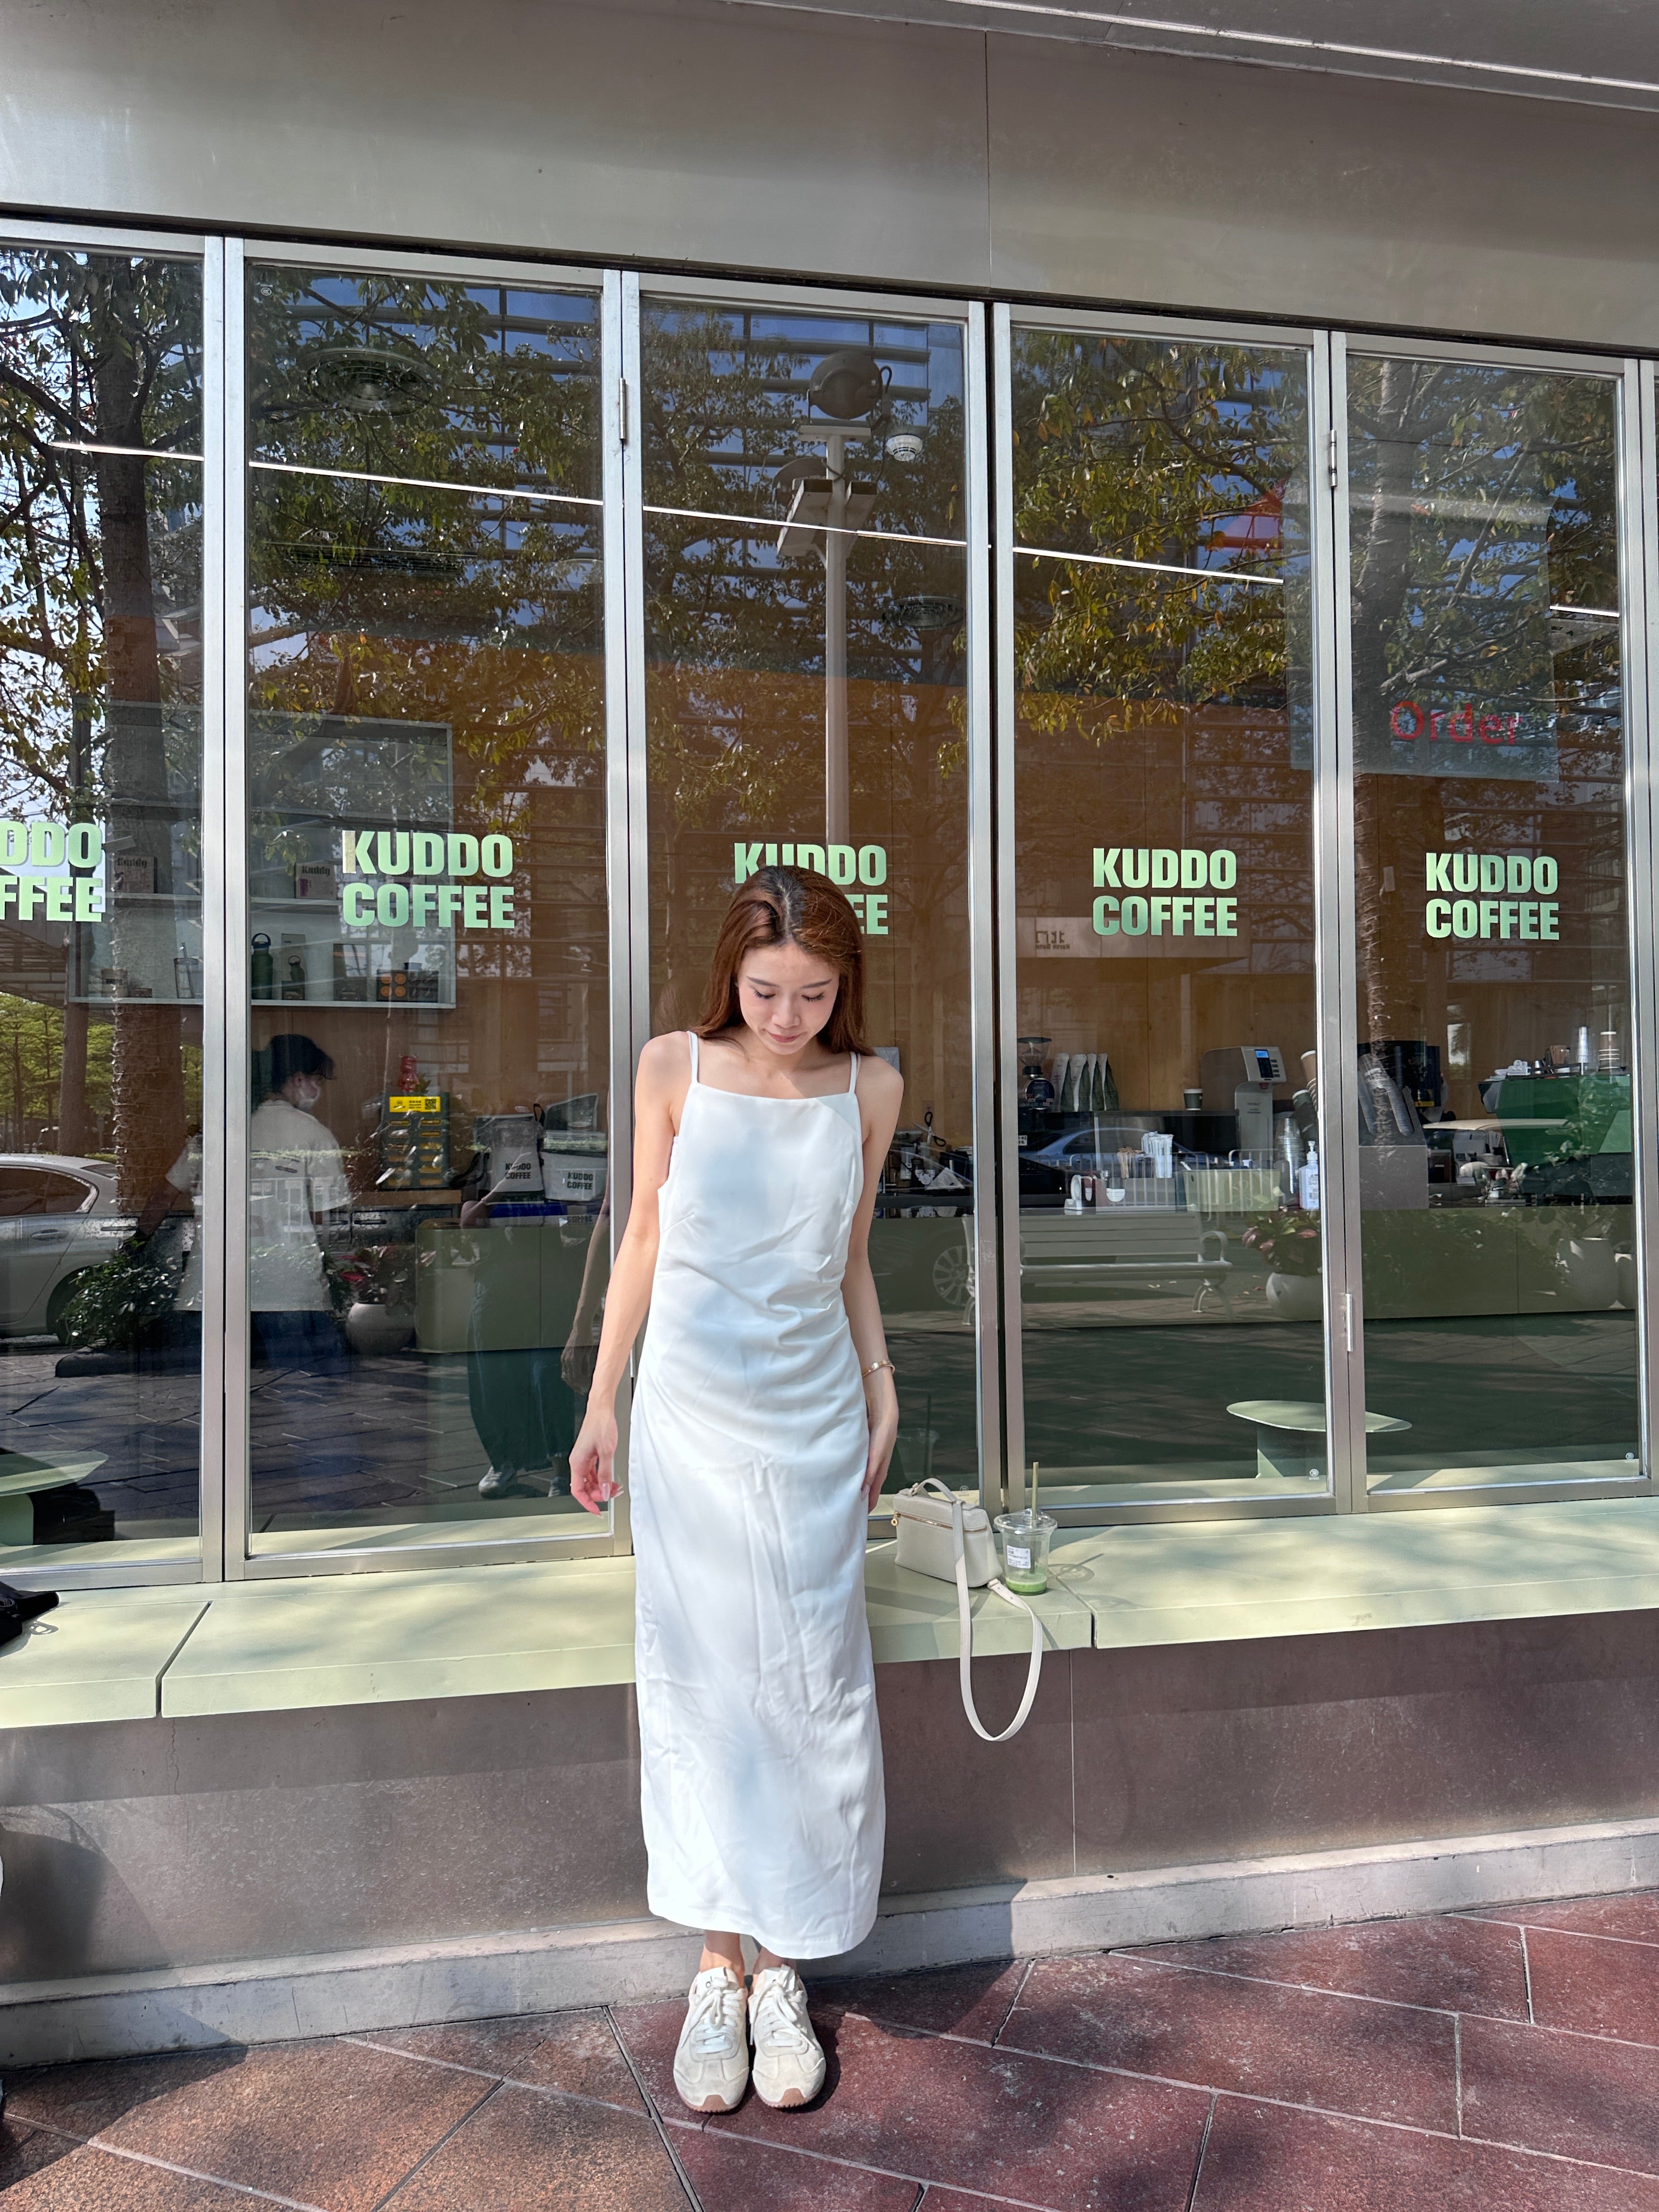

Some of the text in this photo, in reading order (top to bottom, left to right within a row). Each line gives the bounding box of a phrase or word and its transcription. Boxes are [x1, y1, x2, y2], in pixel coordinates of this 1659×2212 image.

[1390, 701, 1523, 744] Order
[342, 830, 513, 877] KUDDO
[1093, 848, 1237, 889] KUDDO
[1426, 853, 1558, 894] KUDDO
[343, 883, 515, 928] COFFEE
[1093, 895, 1237, 936] COFFEE
[1426, 899, 1559, 940] COFFEE
[567, 1181, 592, 1190] COFFEE
[568, 1172, 594, 1181] KUDDO
